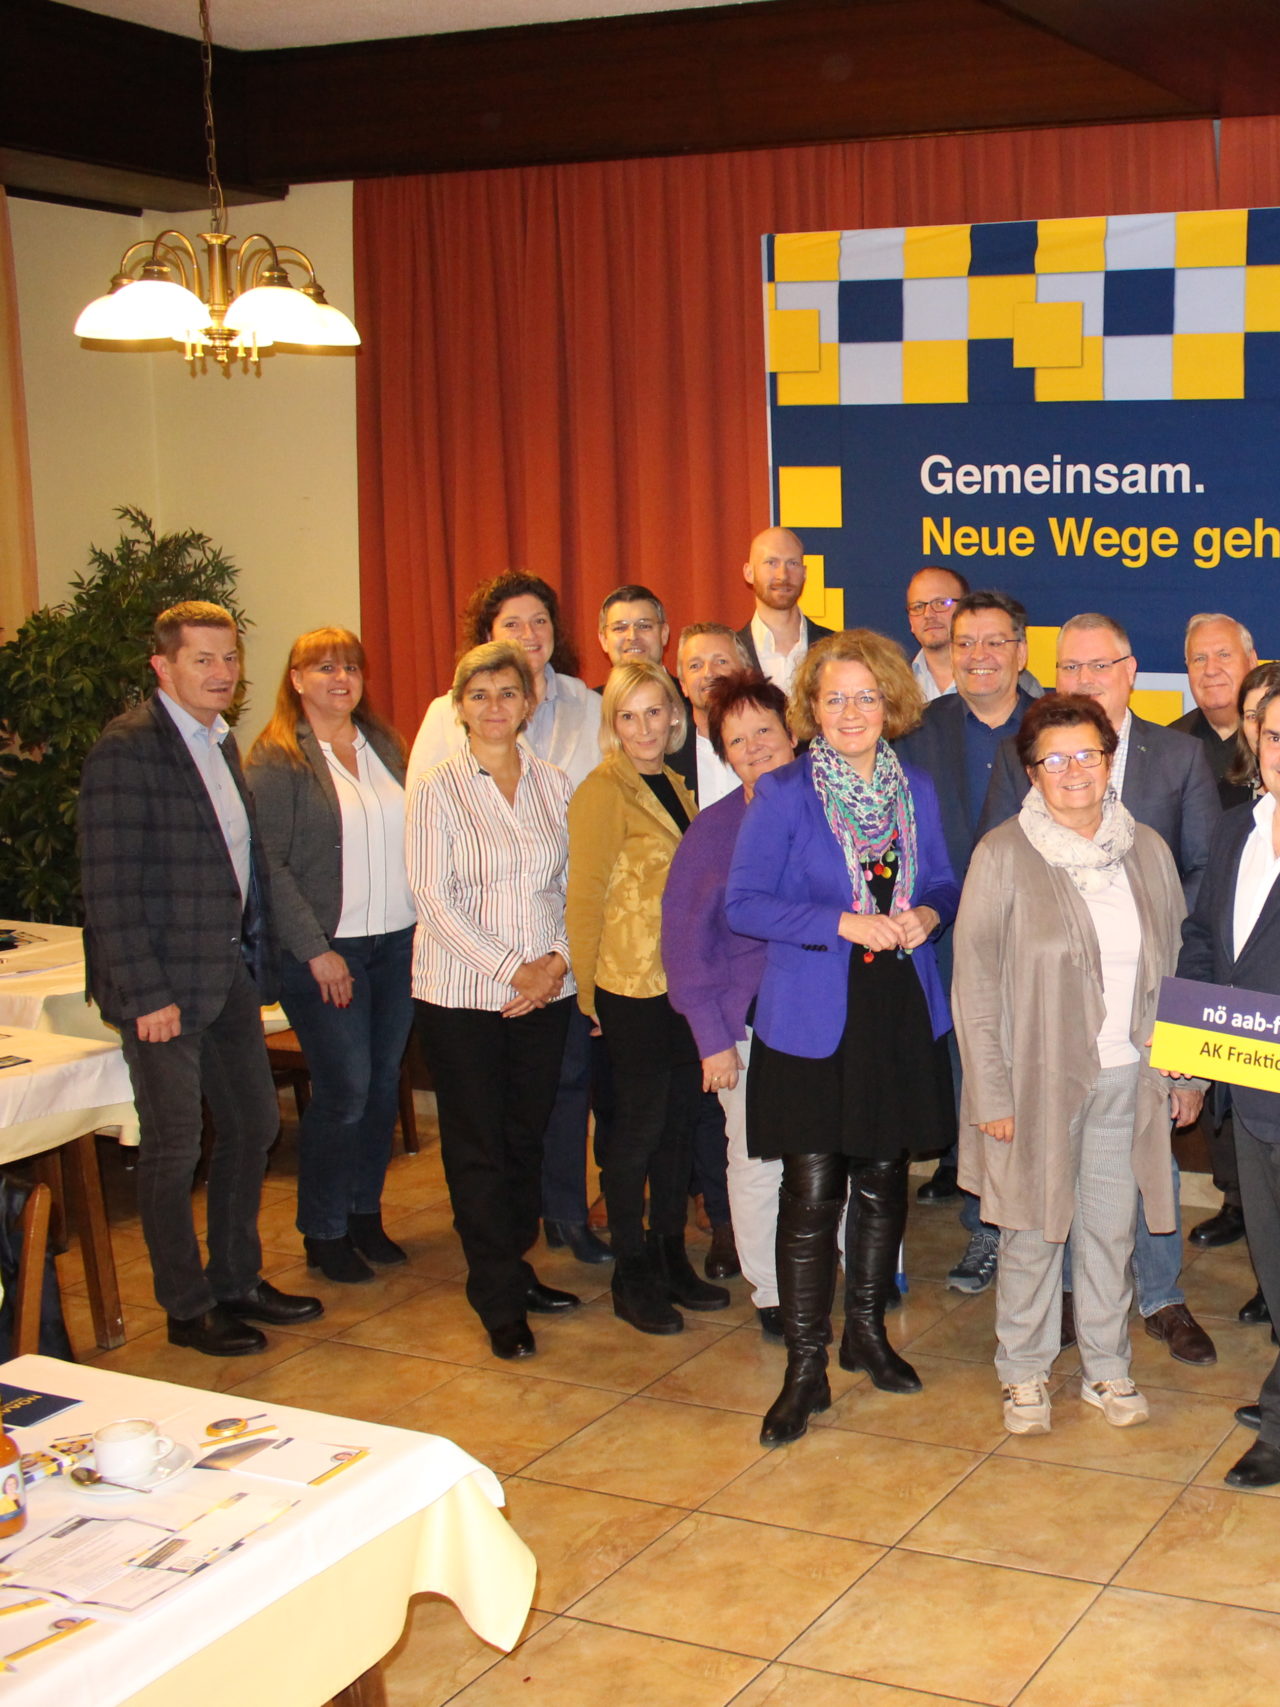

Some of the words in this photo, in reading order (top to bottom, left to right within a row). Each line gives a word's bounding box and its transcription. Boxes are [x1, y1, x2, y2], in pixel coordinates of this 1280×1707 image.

[920, 454, 1205, 495] Gemeinsam.
[922, 516, 1035, 557] Neue
[1047, 517, 1179, 569] Wege
[1202, 1005, 1228, 1025] nö
[1199, 1041, 1223, 1059] AK
